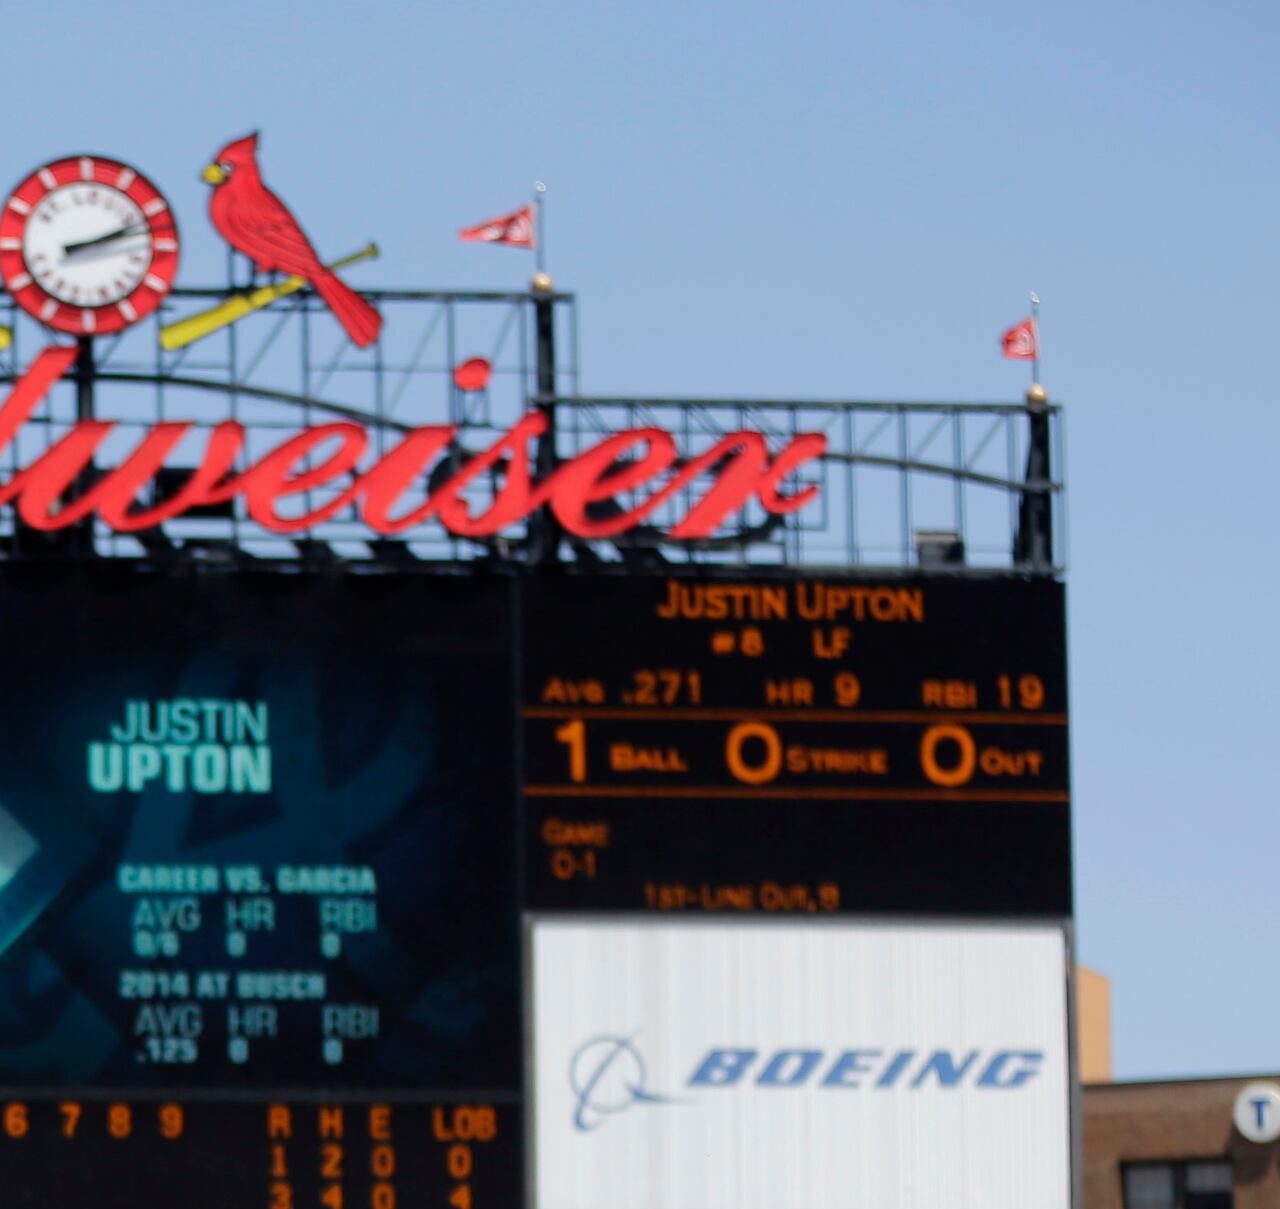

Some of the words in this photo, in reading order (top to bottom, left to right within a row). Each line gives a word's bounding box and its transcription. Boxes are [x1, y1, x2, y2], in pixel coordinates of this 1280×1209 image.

[657, 581, 788, 620] JUSTIN
[797, 582, 924, 621] UPTON
[813, 628, 851, 659] LF
[623, 670, 703, 706] .271
[766, 680, 814, 706] HR
[834, 673, 861, 707] 9
[922, 679, 977, 709] RBI
[997, 674, 1044, 709] 19
[110, 699, 269, 744] JUSTIN
[87, 741, 273, 794] UPTON
[556, 719, 587, 784] 1
[609, 742, 687, 771] BALL
[725, 721, 782, 785] 0
[787, 745, 888, 774] STRIKE
[920, 723, 976, 787] 0
[981, 746, 1042, 776] OUT
[544, 819, 608, 846] GAME
[117, 864, 220, 894] CAREER
[276, 865, 378, 895] GARCIA
[133, 898, 201, 932] AVG
[225, 898, 276, 932] HR
[319, 898, 378, 933] RBI
[119, 970, 190, 999] 2014
[196, 971, 230, 998] AT
[236, 971, 326, 999] BUSCH
[134, 1004, 203, 1037] AVG
[227, 1004, 279, 1038] HR
[321, 1004, 380, 1039] RBI
[684, 1047, 1046, 1089] BOEING
[3, 1103, 29, 1139] 6
[59, 1103, 81, 1138] 7
[108, 1103, 132, 1139] 8
[159, 1103, 183, 1139] 9
[268, 1103, 292, 1139] R
[320, 1104, 344, 1139] H
[369, 1105, 392, 1140] E
[433, 1105, 498, 1142] LOB
[271, 1145, 288, 1177] 1
[320, 1145, 343, 1178] 2
[371, 1145, 395, 1178] 0
[448, 1145, 472, 1179] 0
